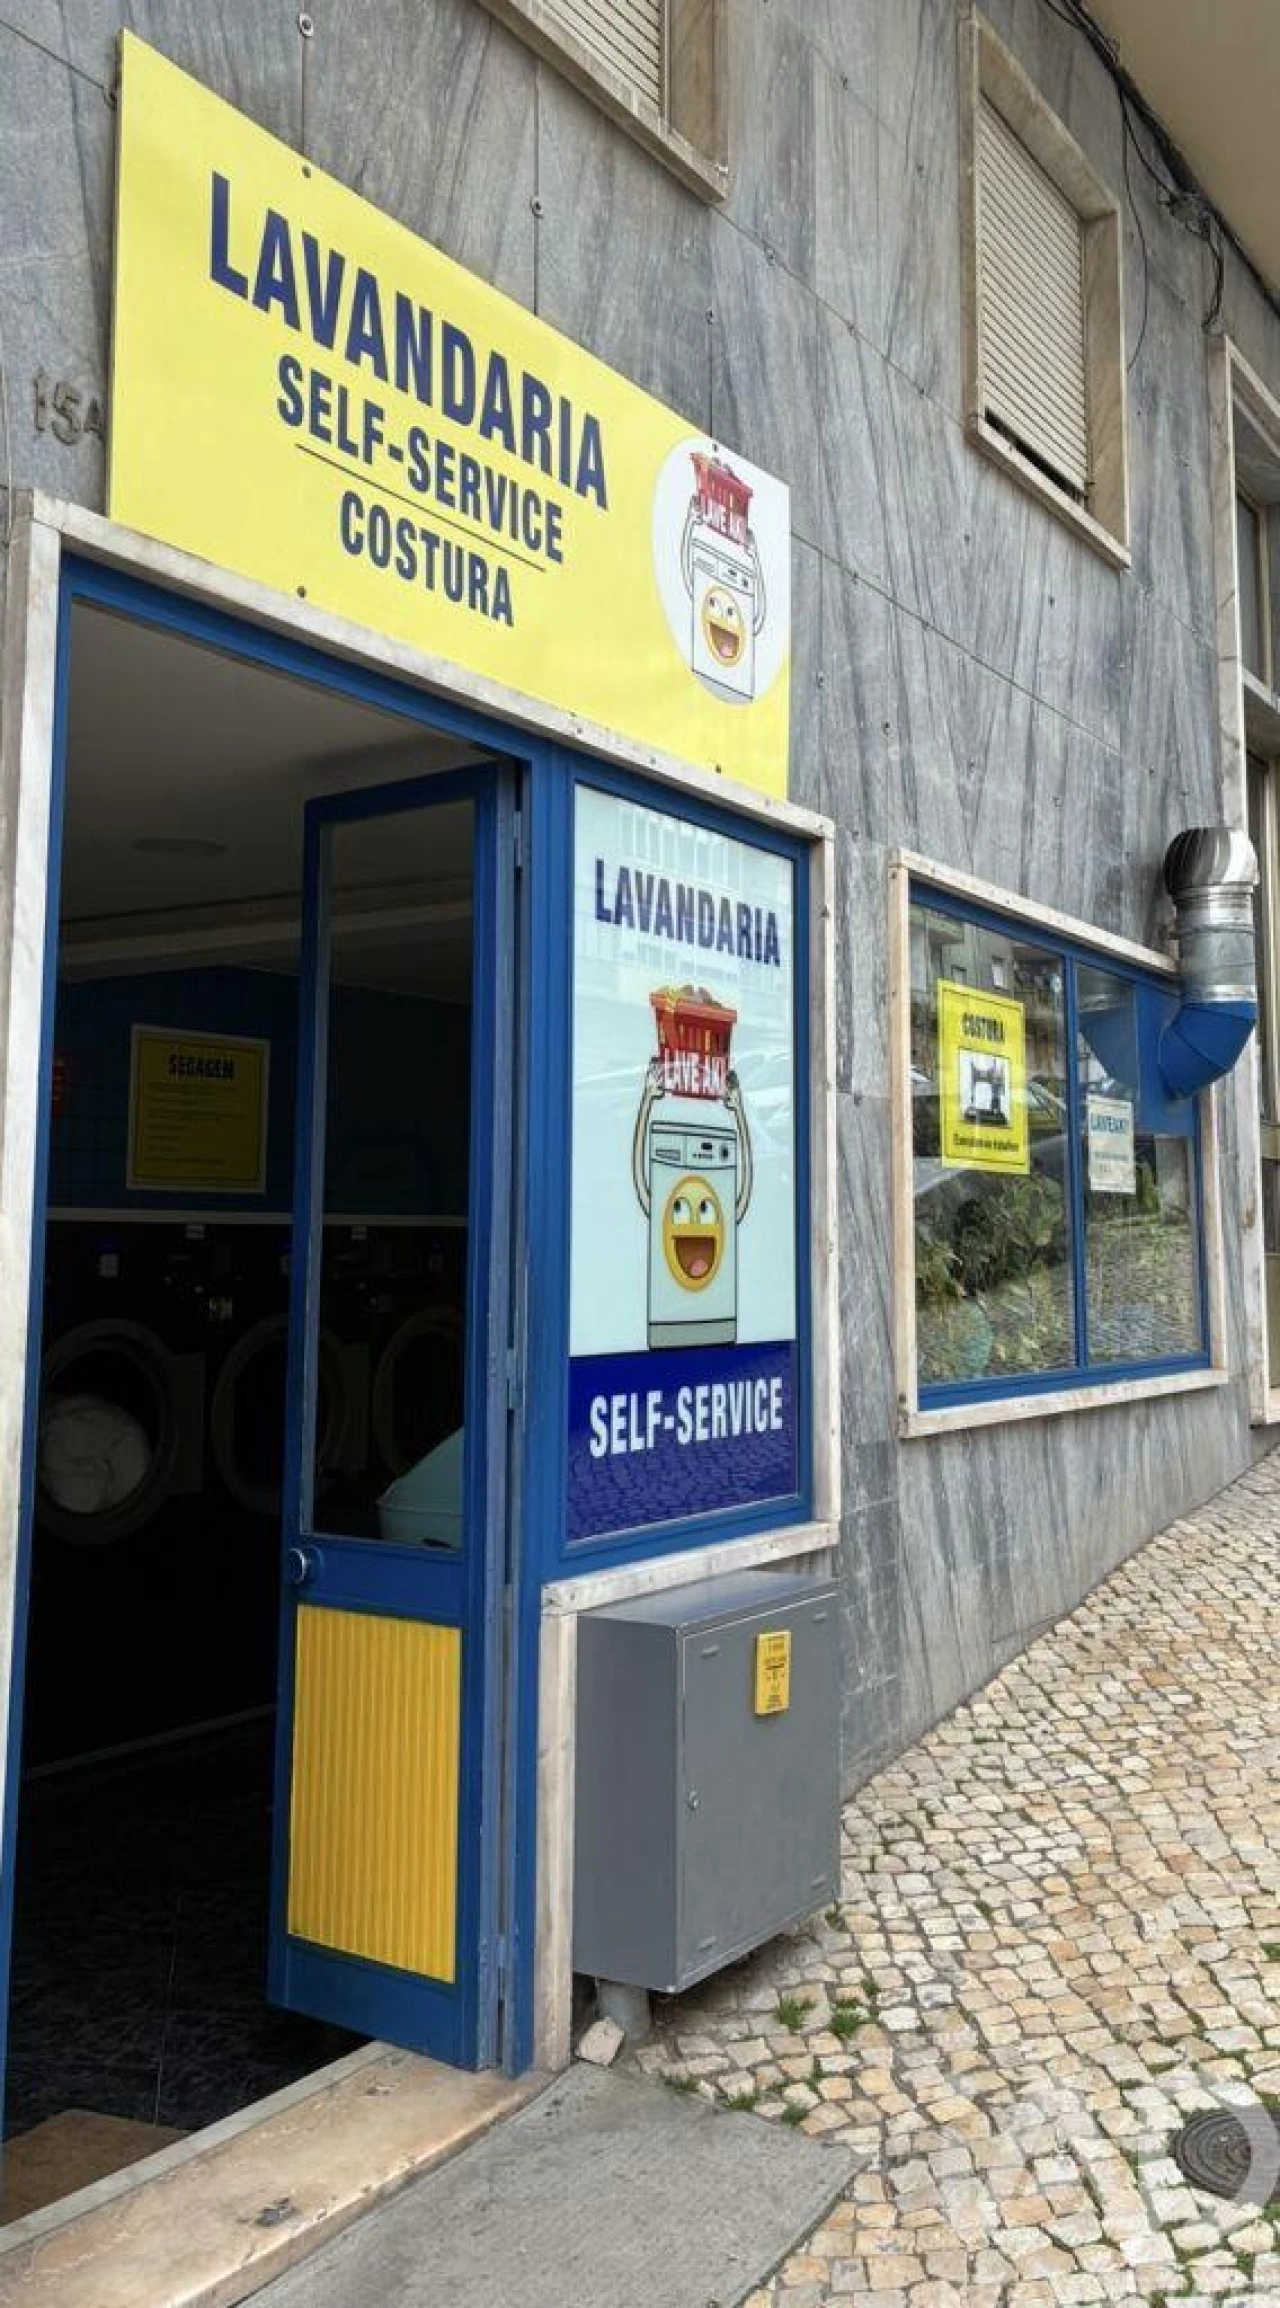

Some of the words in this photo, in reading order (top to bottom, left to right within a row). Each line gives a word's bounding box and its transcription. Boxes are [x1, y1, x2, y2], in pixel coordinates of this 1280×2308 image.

[210, 171, 608, 511] LAVANDARIA
[277, 354, 563, 564] SELF-SERVICE
[340, 491, 515, 628] COSTURA
[595, 858, 781, 968] LAVANDARIA
[589, 1376, 783, 1459] SELF-SERVICE
